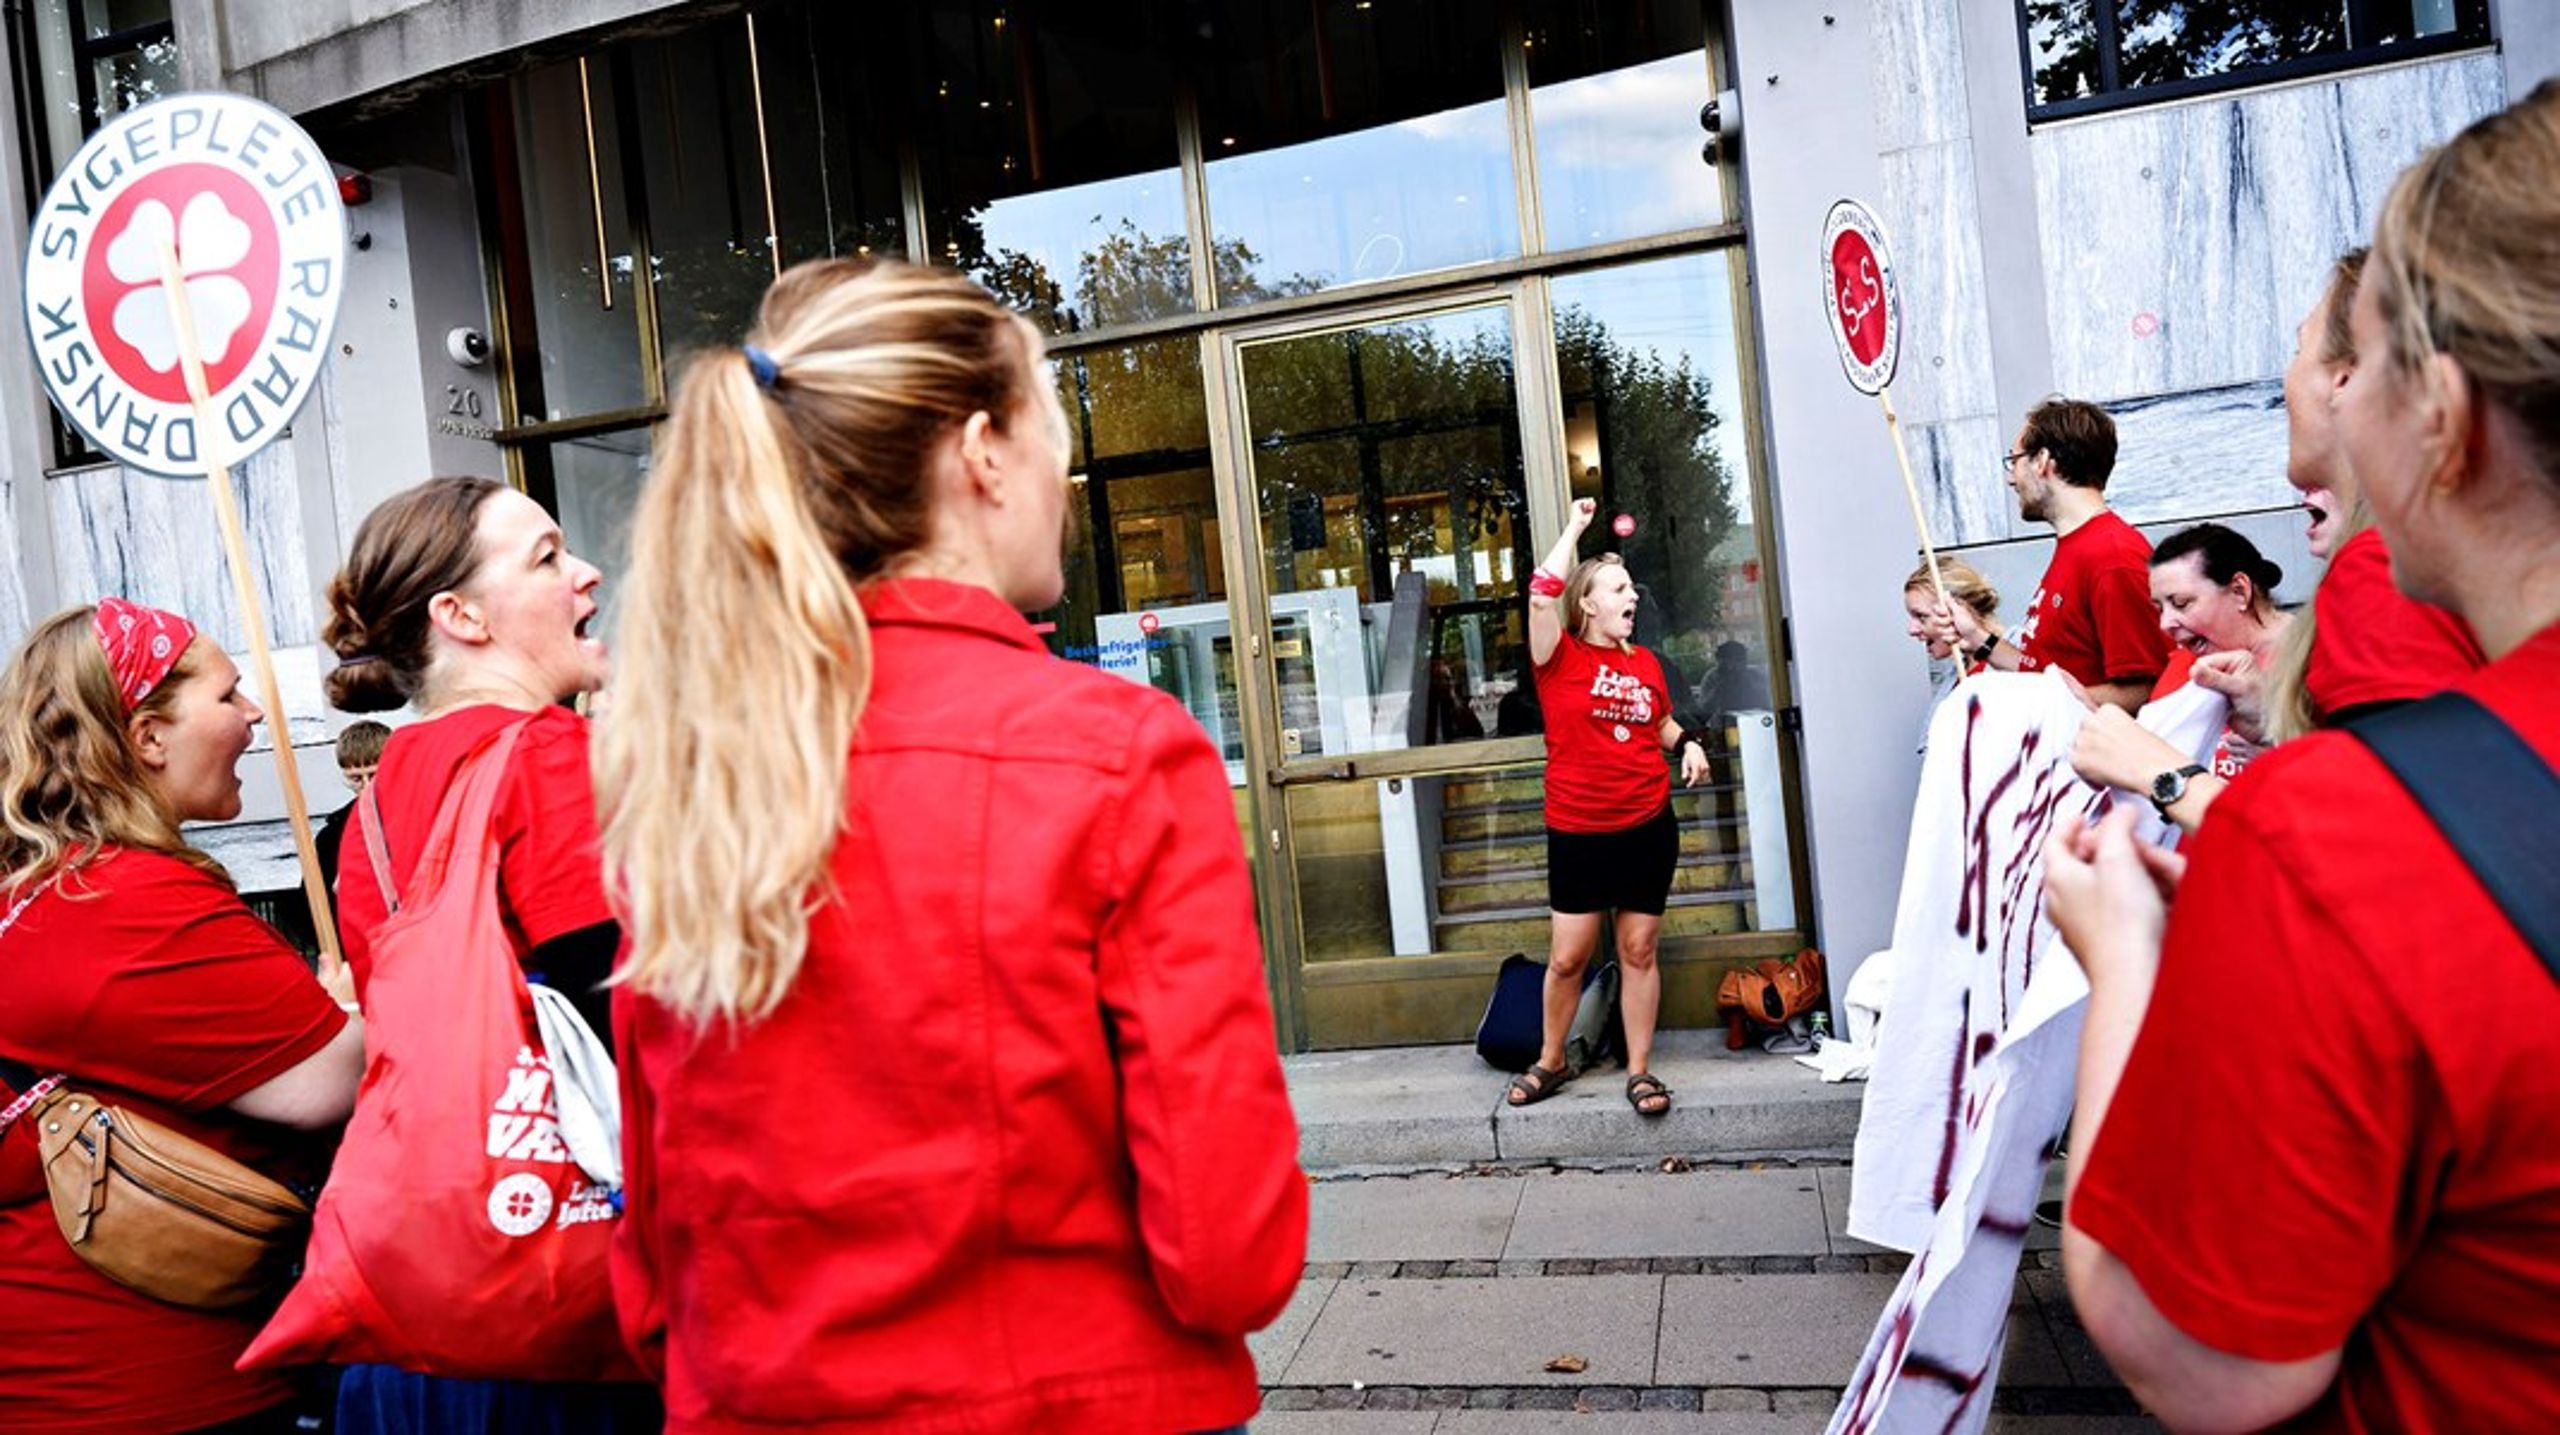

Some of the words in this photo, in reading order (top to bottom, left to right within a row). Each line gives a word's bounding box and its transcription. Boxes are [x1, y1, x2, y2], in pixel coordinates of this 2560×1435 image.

[41, 107, 326, 261] SYGEPLEJE
[37, 296, 198, 462] DANSK
[225, 257, 332, 444] RAAD
[446, 384, 482, 419] 20
[1091, 656, 1138, 670] teriet
[486, 1112, 573, 1164] VÆ
